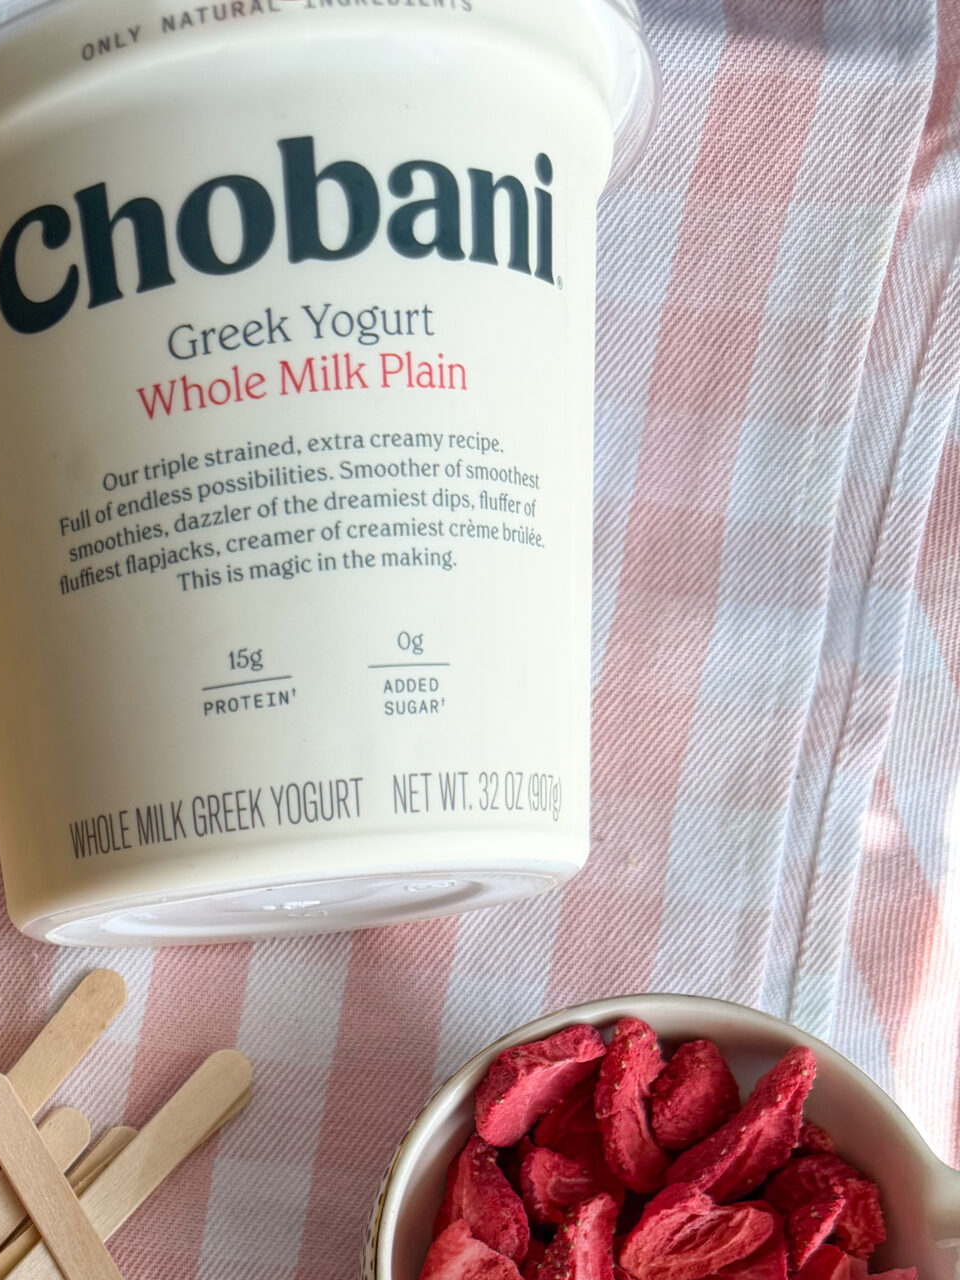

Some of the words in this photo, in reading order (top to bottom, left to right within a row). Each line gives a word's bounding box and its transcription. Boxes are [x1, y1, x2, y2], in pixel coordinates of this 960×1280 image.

[81, 25, 142, 62] ONLY
[161, 0, 281, 34] NATURAL
[167, 308, 292, 361] Greek
[301, 302, 435, 346] Yogurt
[136, 365, 267, 421] Whole
[279, 353, 369, 396] Milk
[380, 351, 469, 391] Plain
[103, 468, 139, 491] Our
[144, 453, 199, 480] triple
[204, 435, 302, 468] strained,
[307, 433, 364, 452] extra
[370, 432, 444, 452] creamy
[448, 432, 504, 455] recipe.
[59, 508, 90, 537] Full
[95, 501, 113, 524] of
[117, 486, 193, 518] endless
[197, 464, 334, 503] possibilities.
[340, 458, 440, 480] Smoother
[444, 459, 464, 478] of
[466, 465, 540, 490] smoothest
[69, 522, 169, 563] smoothies,
[174, 504, 251, 533] dazzler
[257, 497, 279, 519] of
[283, 493, 319, 515] the
[324, 488, 428, 511] dreamiest
[432, 488, 476, 511] dips,
[479, 490, 522, 514] fluffer
[524, 499, 537, 518] of
[59, 562, 122, 596] fluffiest
[125, 541, 221, 574] flapjacks,
[226, 528, 315, 554] creamer
[320, 520, 342, 541] of
[346, 518, 444, 540] creamiest
[448, 519, 500, 540] crème
[502, 522, 546, 549] brûlée.
[178, 568, 222, 592] This
[227, 564, 244, 584] is
[249, 556, 312, 581] magic
[317, 553, 337, 572] in
[342, 549, 376, 570] the
[381, 547, 457, 572] making.
[228, 648, 264, 672] 15g
[397, 631, 424, 655] 0g
[384, 678, 439, 694] ADDED
[70, 809, 132, 860] WHOLE
[135, 802, 187, 847] MILK
[192, 787, 266, 838] GREEK
[269, 777, 364, 826] YOGURT
[393, 773, 432, 815] NET
[438, 771, 473, 812] WT.
[478, 770, 499, 811] 32
[504, 770, 524, 811] OZ
[528, 772, 563, 822] (907g)
